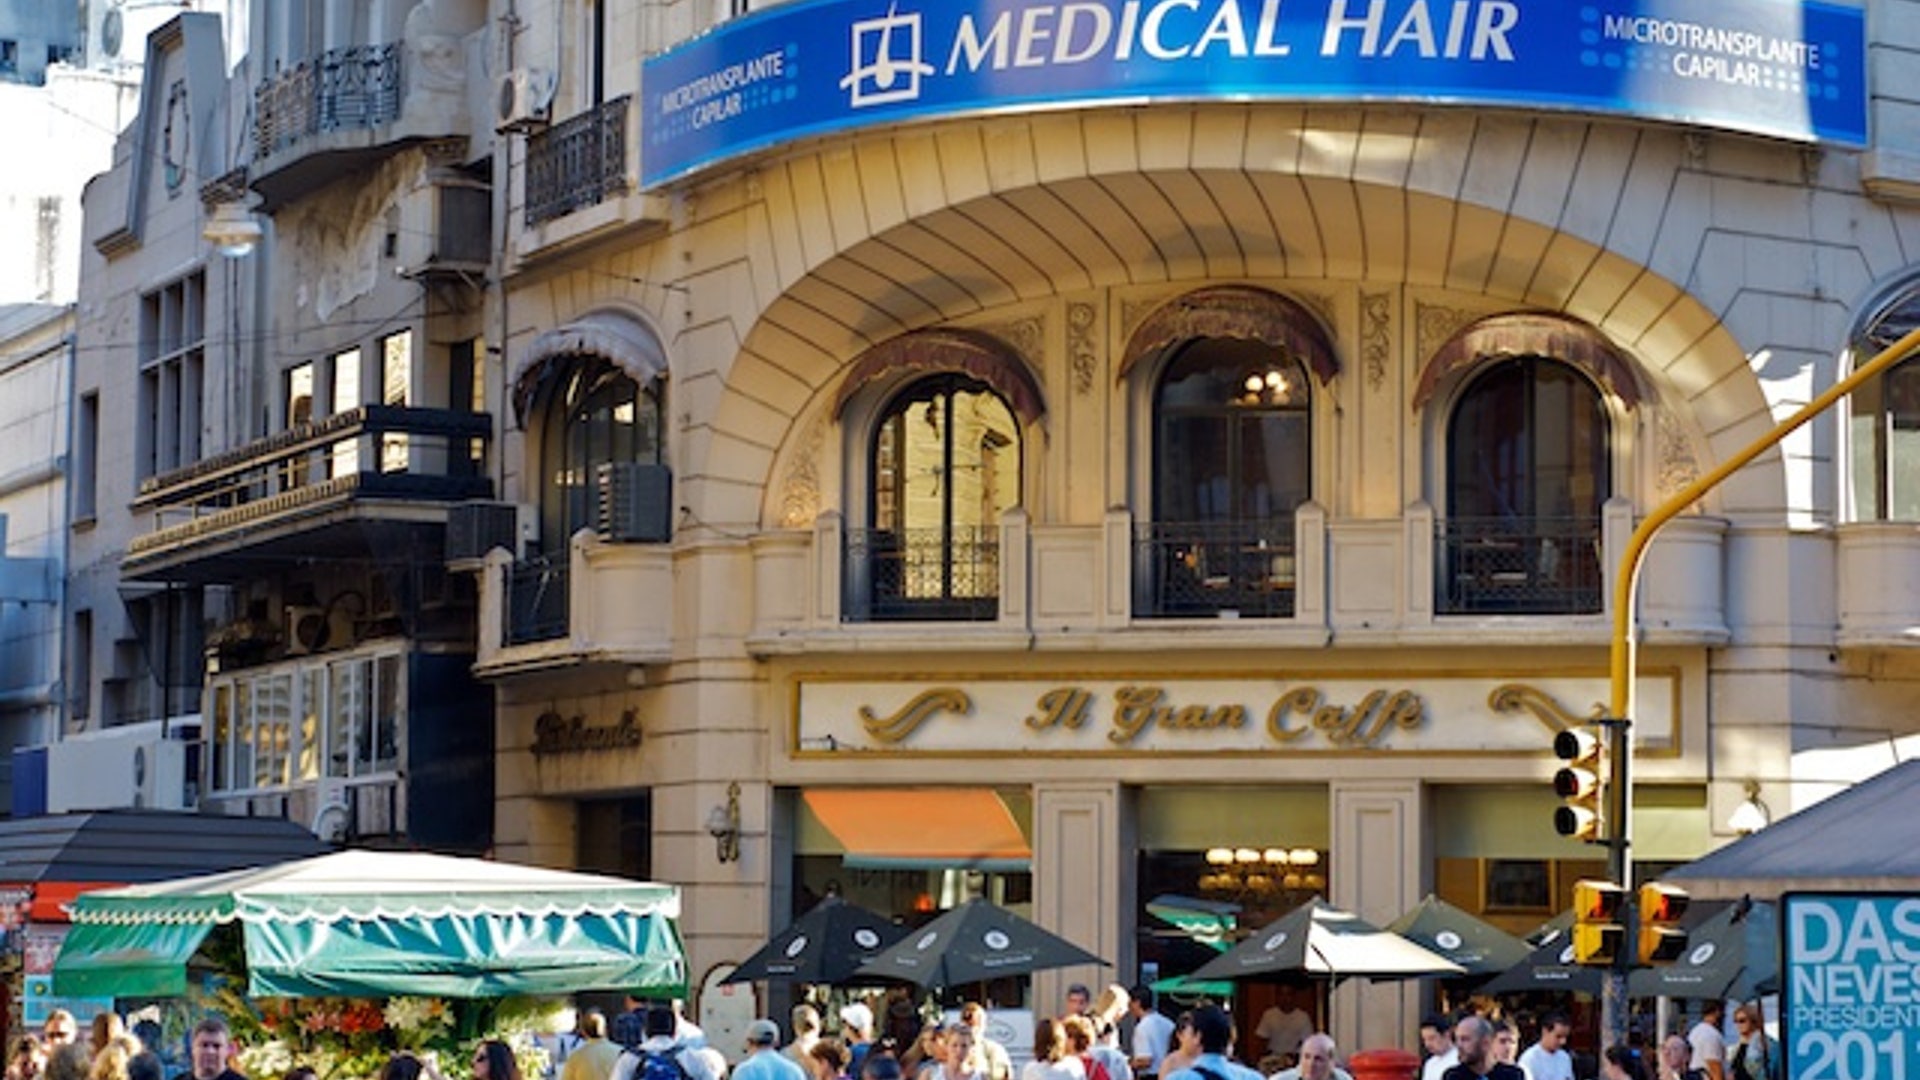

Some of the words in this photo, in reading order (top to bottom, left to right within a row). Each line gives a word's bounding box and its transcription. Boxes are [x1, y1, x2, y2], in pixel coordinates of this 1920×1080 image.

[944, 0, 1291, 76] MEDICAL
[1320, 0, 1518, 61] HAIR
[1604, 15, 1819, 69] MICROTRANSPLANTE
[661, 51, 784, 114] MICROTRANSPLANTE
[1673, 53, 1760, 86] CAPILAR
[692, 93, 742, 129] CAPILAR
[1025, 686, 1095, 731] Il
[1107, 686, 1249, 744] Gran
[1790, 898, 1920, 964] DAS
[1796, 1029, 1920, 1080] 201
